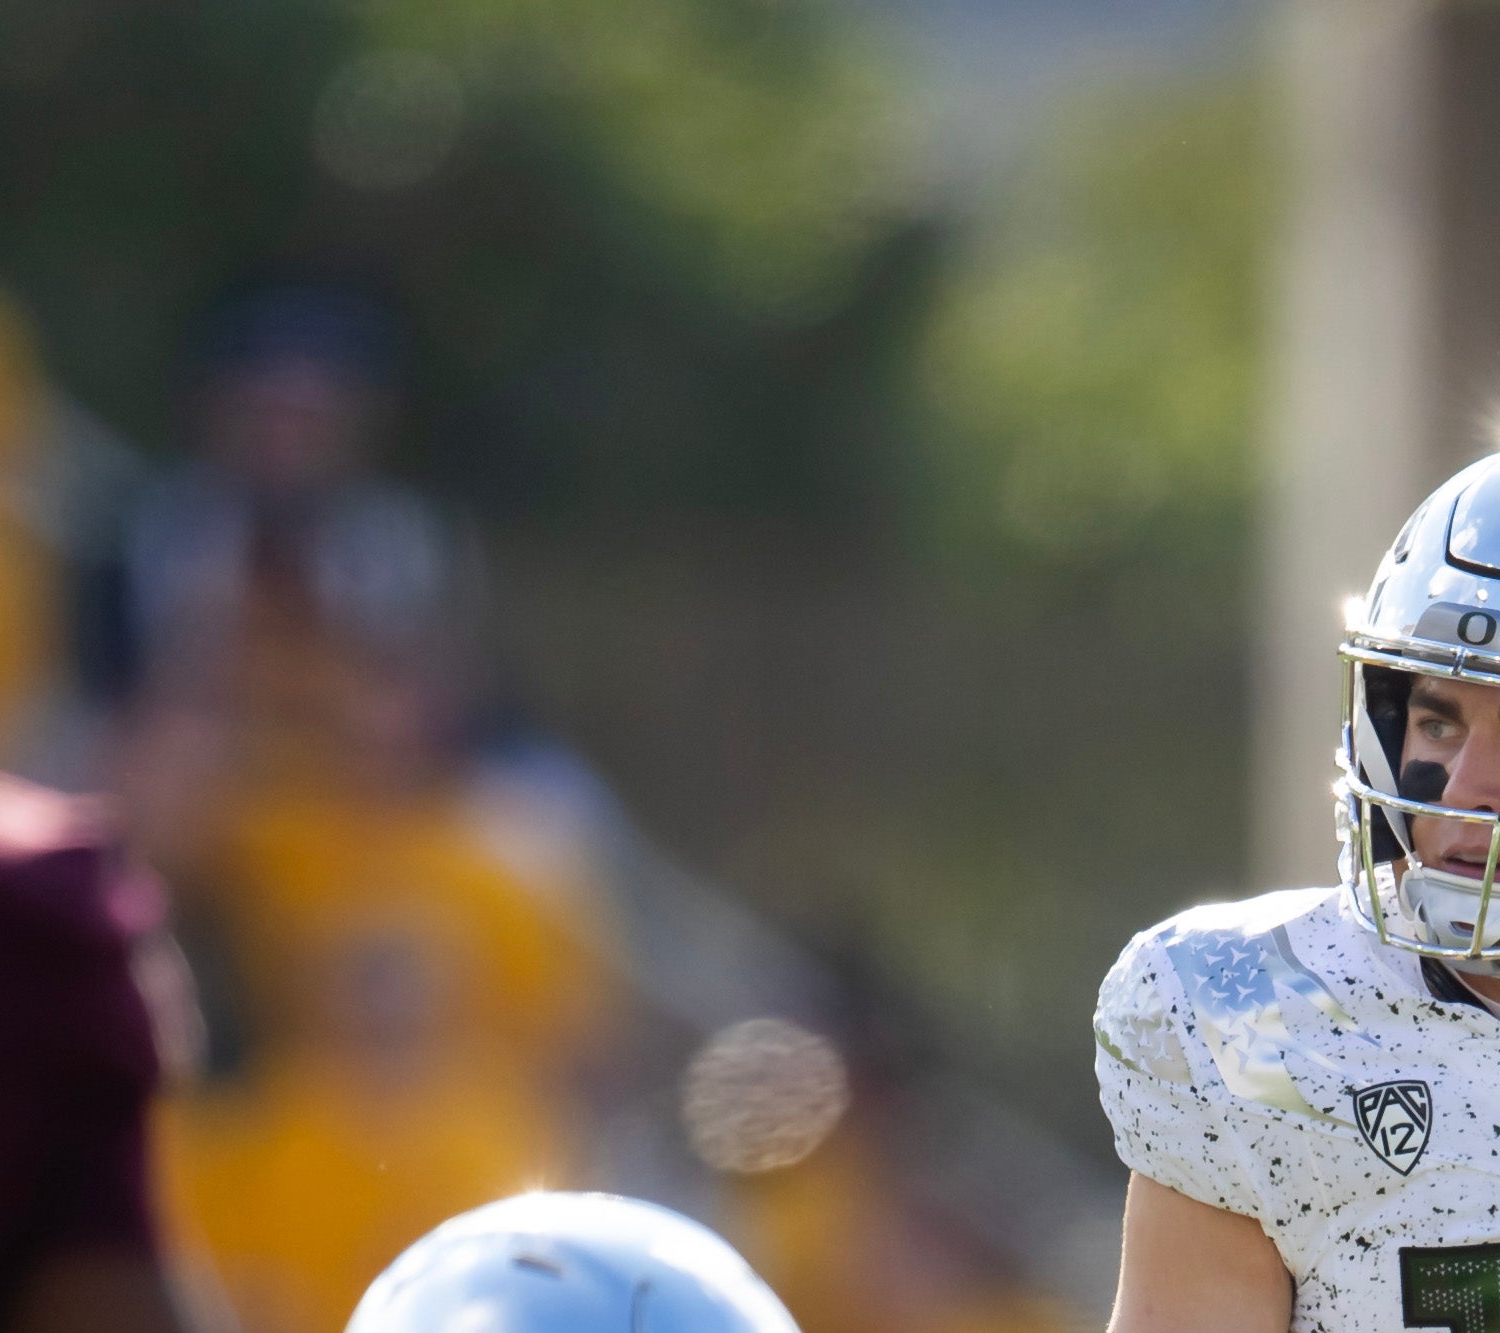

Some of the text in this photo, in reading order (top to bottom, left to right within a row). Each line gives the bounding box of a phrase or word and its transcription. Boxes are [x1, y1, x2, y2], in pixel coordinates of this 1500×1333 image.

[1457, 611, 1497, 645] O
[1359, 1085, 1426, 1141] PAC
[1380, 1122, 1419, 1157] 12
